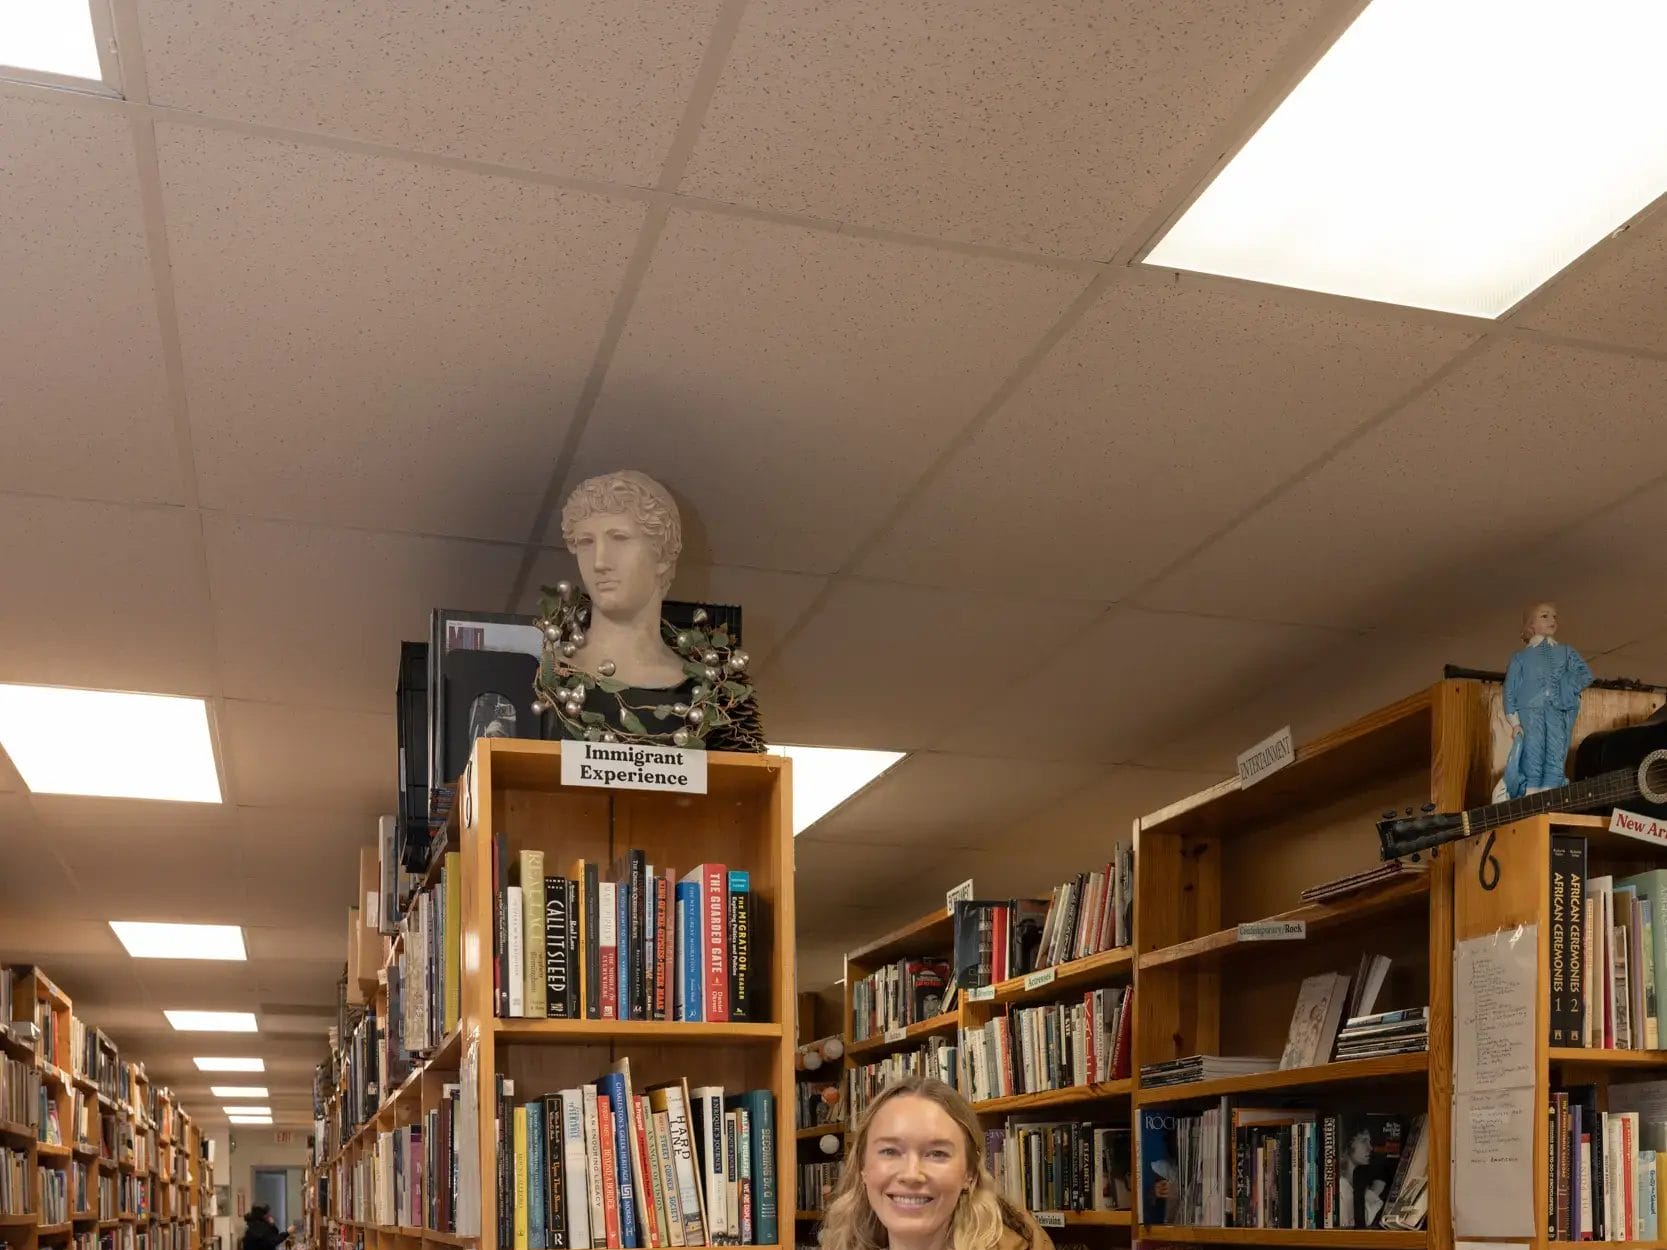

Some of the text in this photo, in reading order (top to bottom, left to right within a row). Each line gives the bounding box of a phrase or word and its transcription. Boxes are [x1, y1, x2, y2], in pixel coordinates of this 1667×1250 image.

[580, 765, 688, 786] Experience
[585, 744, 683, 766] Immigrant
[1240, 736, 1291, 782] ENTERTAINMENT
[1616, 814, 1644, 833] New
[1479, 830, 1500, 891] 6
[657, 879, 665, 899] KING
[658, 901, 665, 909] OF
[547, 900, 566, 991] CALL IT SLEEP
[710, 873, 722, 973] THE GUARDED GATE
[738, 911, 747, 971] MIGRATION
[1553, 872, 1563, 1012] AFRICAN CEREMONIES 1
[1570, 872, 1581, 1013] AFRICAN CEREMONIES 2
[657, 988, 666, 1009] MAAS
[615, 1082, 629, 1182] CHARLESTON'S GREEK HERITAGE
[635, 1108, 644, 1131] Prepared
[676, 1115, 691, 1160] HARD
[713, 1098, 722, 1172] ENRIQUE'S JOURNEY
[590, 1114, 601, 1207] AN ENDURING LEGACY
[649, 1142, 663, 1212] ANGLE OF VISION
[728, 1154, 736, 1181] JOURNEY
[1325, 1148, 1334, 1188] MORRIS
[552, 1162, 561, 1212] Upon Shores
[663, 1164, 673, 1192] CORNER
[668, 1195, 679, 1224] SOCIETY
[743, 1183, 750, 1193] WE
[624, 1200, 632, 1225] MORRIS
[1035, 1215, 1062, 1225] Television
